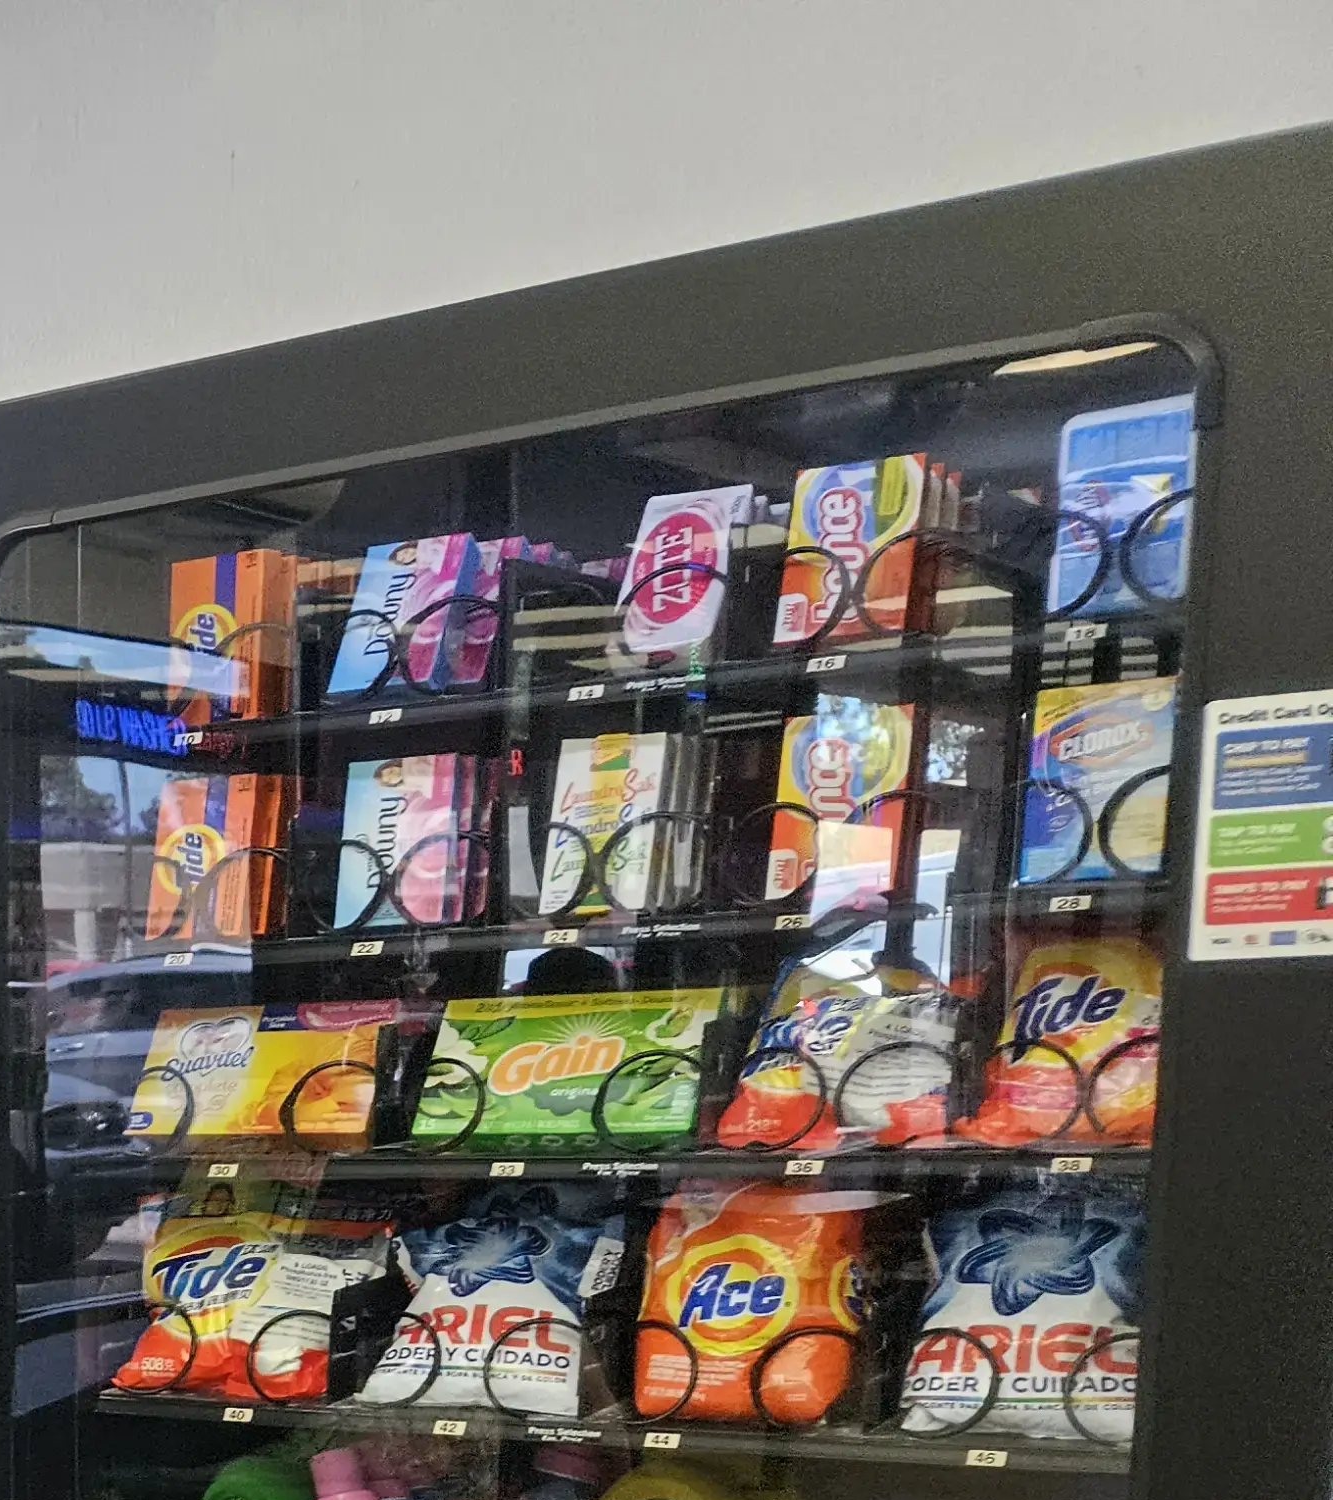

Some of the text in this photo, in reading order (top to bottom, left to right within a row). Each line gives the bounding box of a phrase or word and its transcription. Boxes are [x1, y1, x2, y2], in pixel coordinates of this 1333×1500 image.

[363, 573, 417, 657] Downy
[817, 658, 833, 669] 16
[577, 689, 594, 698] 14
[376, 712, 393, 723] 12
[1218, 709, 1268, 726] Credit
[1274, 704, 1312, 719] Card
[1059, 720, 1144, 762] CLOROX
[365, 796, 407, 889] Downy
[1059, 899, 1081, 910] 28
[782, 917, 803, 928] 26
[550, 932, 568, 942] 24
[357, 944, 375, 954] 22
[168, 955, 185, 965] 20
[1010, 975, 1128, 1063] Tide
[161, 1046, 255, 1081] Suavitel
[490, 1034, 624, 1093] Gain
[213, 1166, 230, 1176] 30
[498, 1165, 515, 1175] 33
[792, 1161, 813, 1172] 36
[1058, 1160, 1081, 1171] 38
[152, 1245, 267, 1300] Tide
[678, 1263, 788, 1327] Ace
[398, 1304, 571, 1354] ARIEL
[908, 1322, 1138, 1376] ARIEL
[229, 1410, 244, 1420] 40
[440, 1422, 457, 1433] 42
[651, 1434, 669, 1445] 44
[974, 1454, 995, 1465] 46
